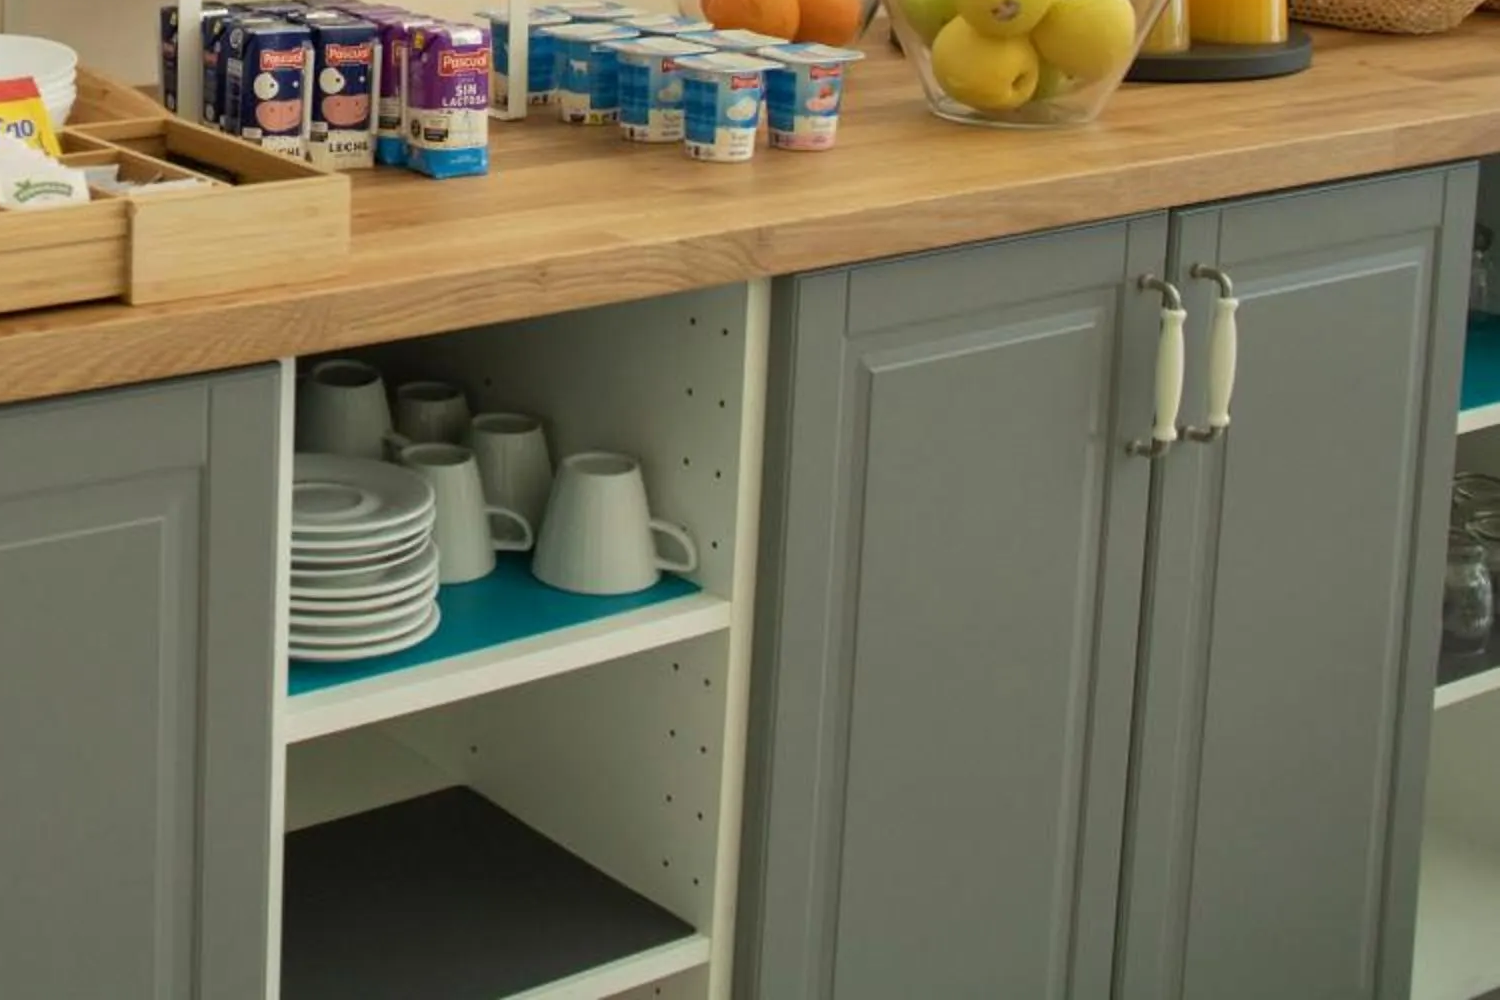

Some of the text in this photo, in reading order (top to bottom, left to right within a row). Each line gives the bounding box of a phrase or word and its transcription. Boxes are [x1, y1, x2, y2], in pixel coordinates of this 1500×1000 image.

[442, 52, 488, 70] Pascual
[455, 83, 478, 97] SIN
[329, 141, 369, 154] LECHE
